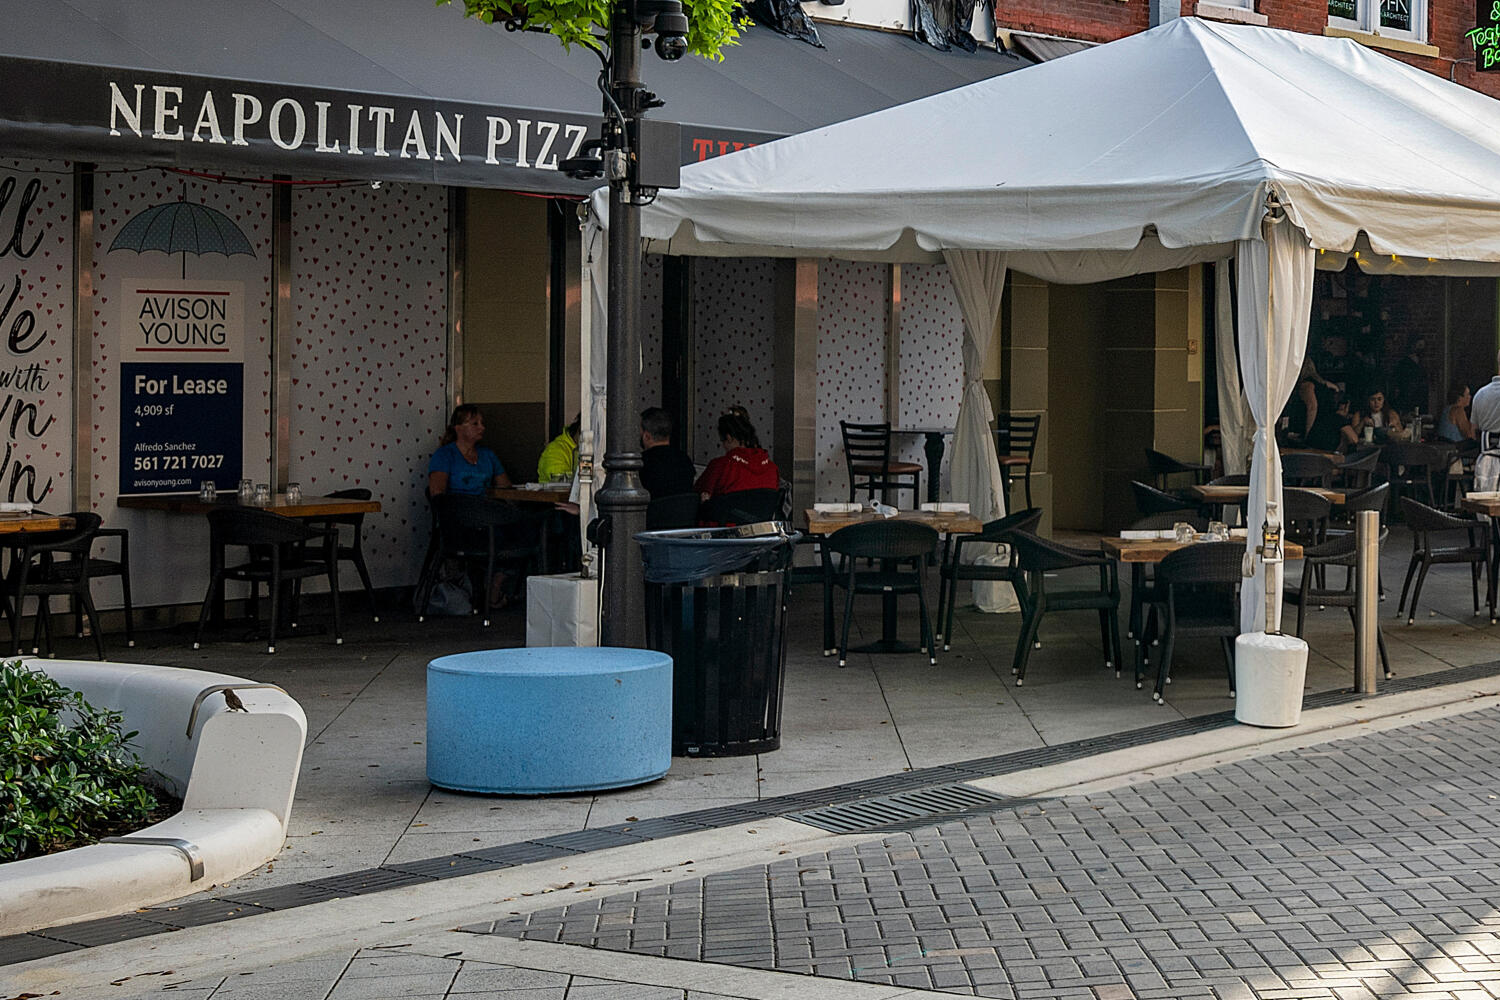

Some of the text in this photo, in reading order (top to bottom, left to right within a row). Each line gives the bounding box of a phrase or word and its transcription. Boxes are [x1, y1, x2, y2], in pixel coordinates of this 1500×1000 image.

[109, 81, 602, 171] NEAPOLITAN PIZZ
[139, 297, 226, 320] AVISON
[139, 322, 226, 345] YOUNG
[135, 375, 228, 395] For Lease
[135, 404, 174, 417] 4,909 sf
[134, 442, 196, 452] Alfredo Sanchez
[134, 455, 224, 470] 561 721 7027
[134, 478, 192, 488] avisonyoung.com
